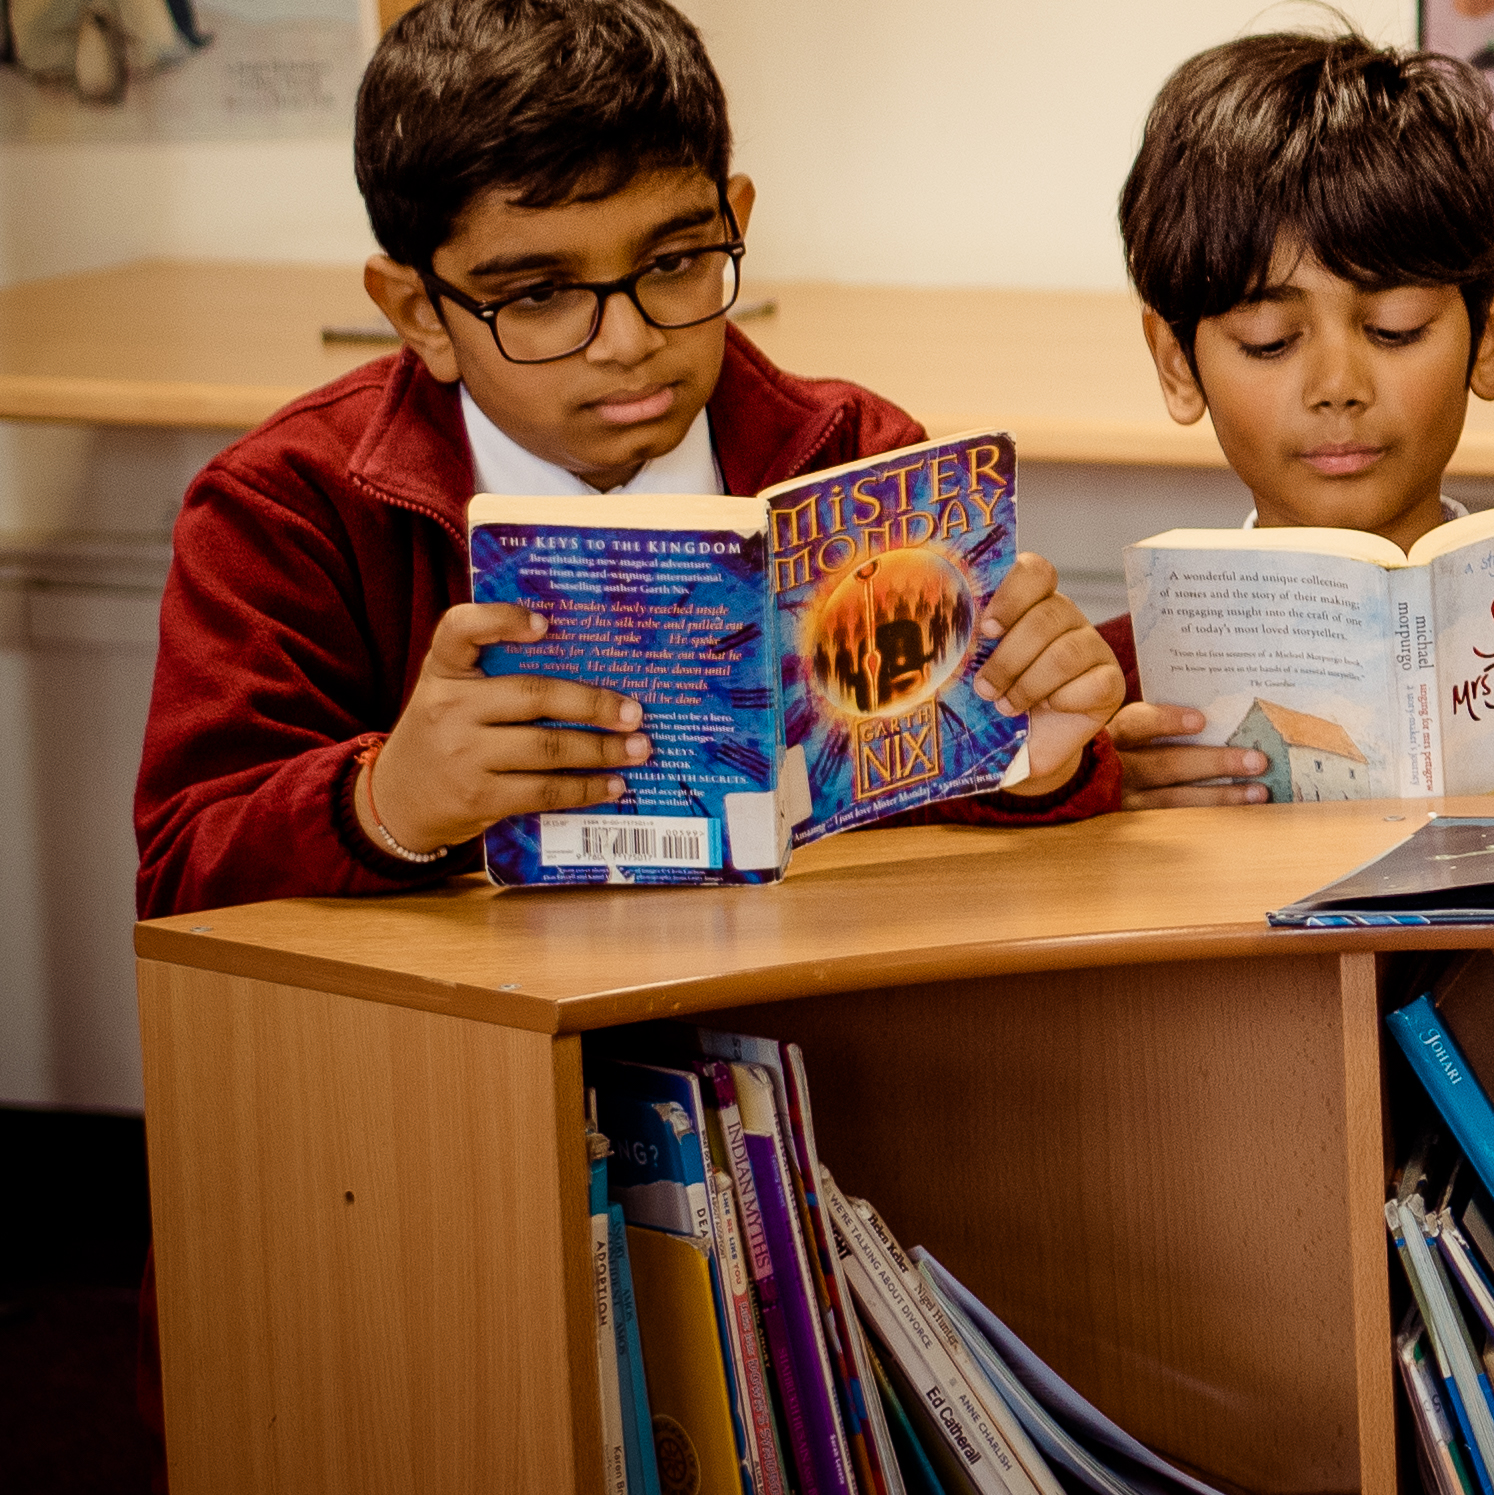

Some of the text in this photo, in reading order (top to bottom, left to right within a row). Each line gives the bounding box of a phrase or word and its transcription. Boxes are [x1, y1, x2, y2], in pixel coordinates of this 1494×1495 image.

[499, 536, 742, 554] THE KEYS TO THE KINGDOM
[529, 554, 712, 570] Breathtaking new magical adventure
[774, 488, 1006, 594] MONDAY
[550, 581, 670, 595] bestselling author Garth
[1160, 587, 1170, 598] of
[1175, 589, 1207, 599] stories
[1210, 589, 1230, 599] and
[1232, 589, 1249, 600] the
[1252, 590, 1276, 602] story
[1279, 590, 1290, 600] of
[1294, 592, 1317, 603] their
[1169, 570, 1349, 590] A wonderful and unique collection
[610, 602, 648, 617] slowly
[687, 619, 724, 632] pulled
[1161, 606, 1363, 627] an engaging insight into the craft of one
[1181, 623, 1192, 634] of
[1195, 623, 1231, 636] today's
[1234, 625, 1259, 634] most
[1262, 624, 1290, 635] loved
[1395, 602, 1413, 671] morpurgo
[1415, 615, 1434, 670] michael
[1452, 673, 1492, 722] Mrs
[863, 707, 931, 742] GARTH
[862, 725, 934, 791] NIX
[727, 1120, 754, 1196] INDIAN
[744, 1197, 771, 1270] MYTHS
[722, 1192, 731, 1216] LIKE
[728, 1237, 738, 1261] LIKE
[733, 1263, 742, 1285] YOU
[867, 1213, 910, 1274] Helen Keller
[596, 1240, 608, 1326] ADOPTION
[830, 1194, 933, 1350] WE'RE TALKING ABOUT DIVORCE
[914, 1281, 935, 1313] Nigel
[926, 1385, 983, 1467] Ed Catherall
[958, 1393, 1013, 1473] ANNE CHARLISH
